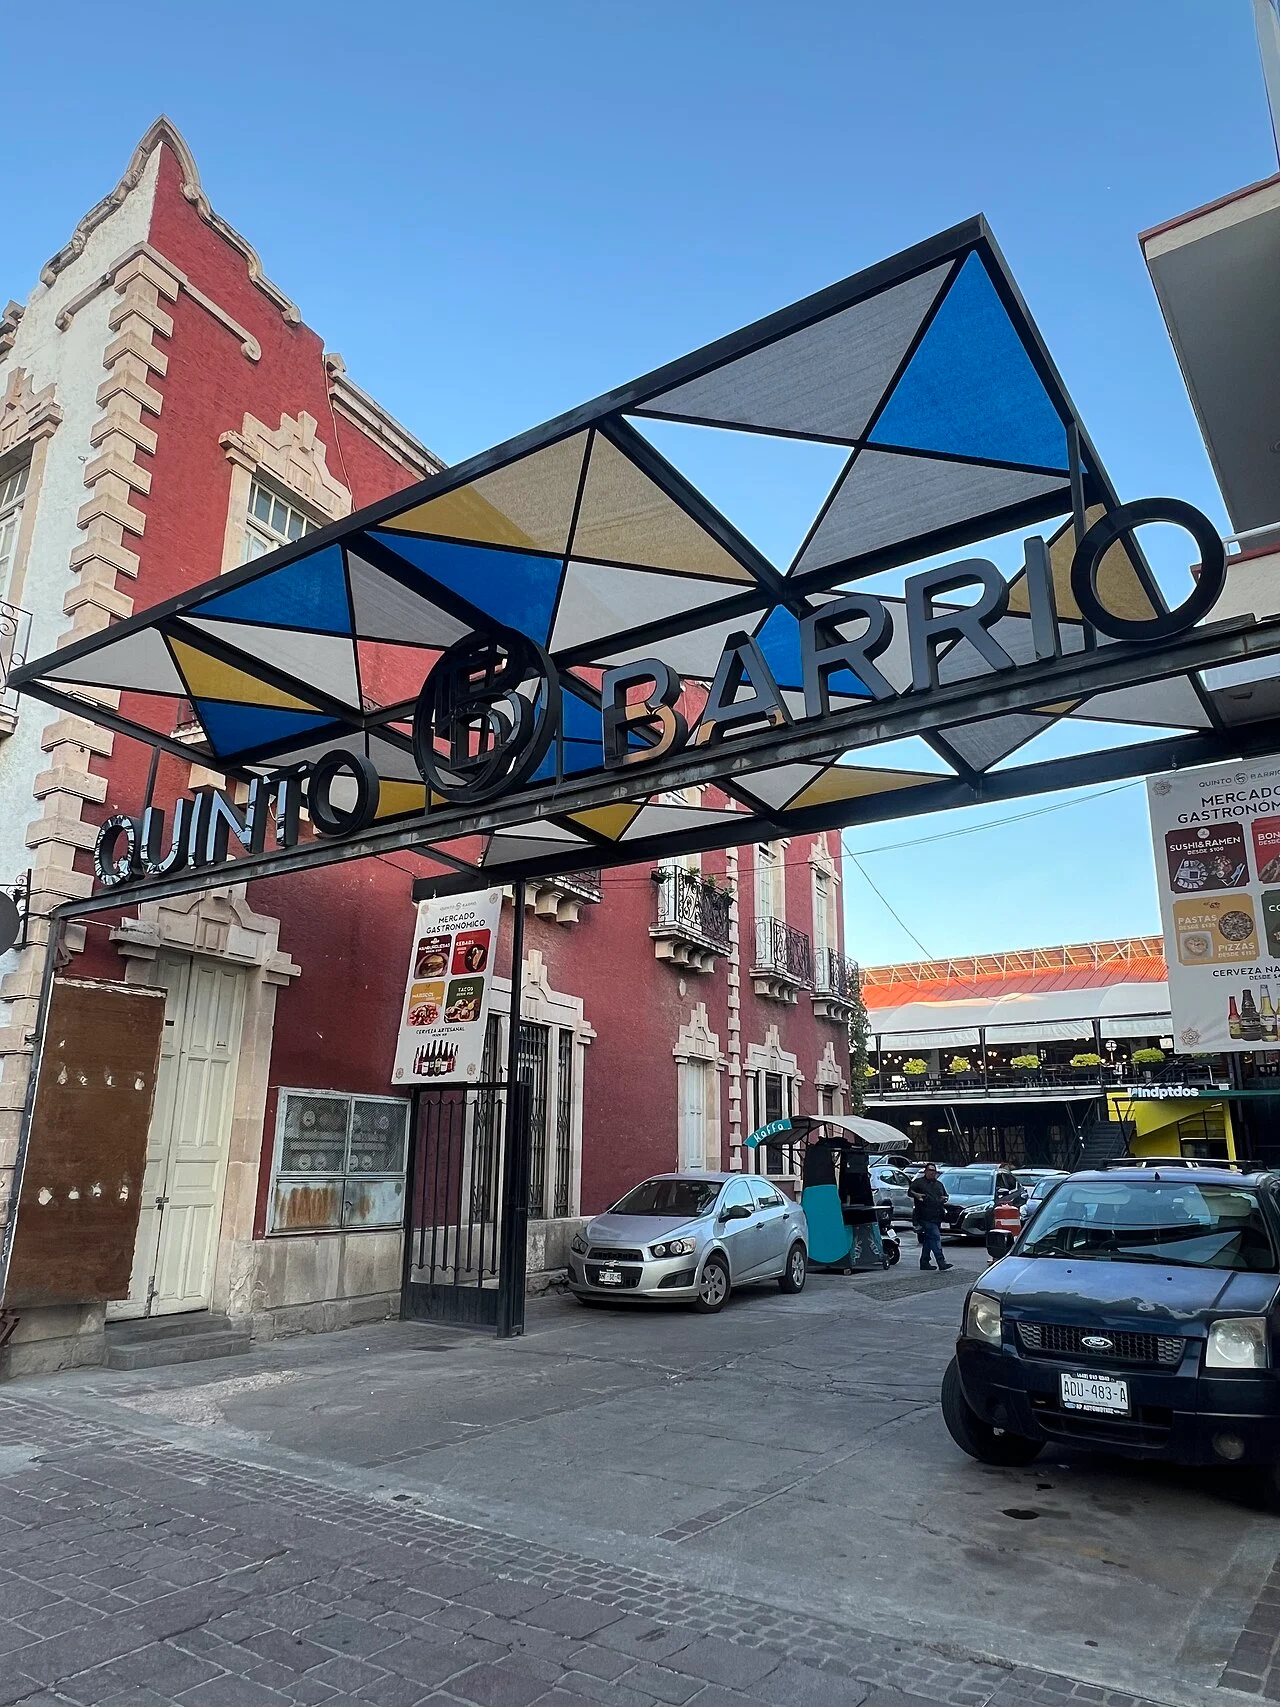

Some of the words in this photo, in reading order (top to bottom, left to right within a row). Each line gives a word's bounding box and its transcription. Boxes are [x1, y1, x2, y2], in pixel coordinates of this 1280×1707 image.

[94, 749, 379, 886] QUINTO
[602, 497, 1227, 771] BARRIO
[1199, 778, 1232, 788] QUINTO
[1201, 786, 1280, 807] MERCADO
[1169, 836, 1241, 852] SUSHI&RAMEN
[438, 912, 475, 923] MERCADO
[1178, 914, 1218, 925] PASTAS
[1218, 942, 1255, 952] PIZZAS
[1212, 967, 1262, 977] CERVEZA
[1064, 1380, 1127, 1403] ADU-483-A
